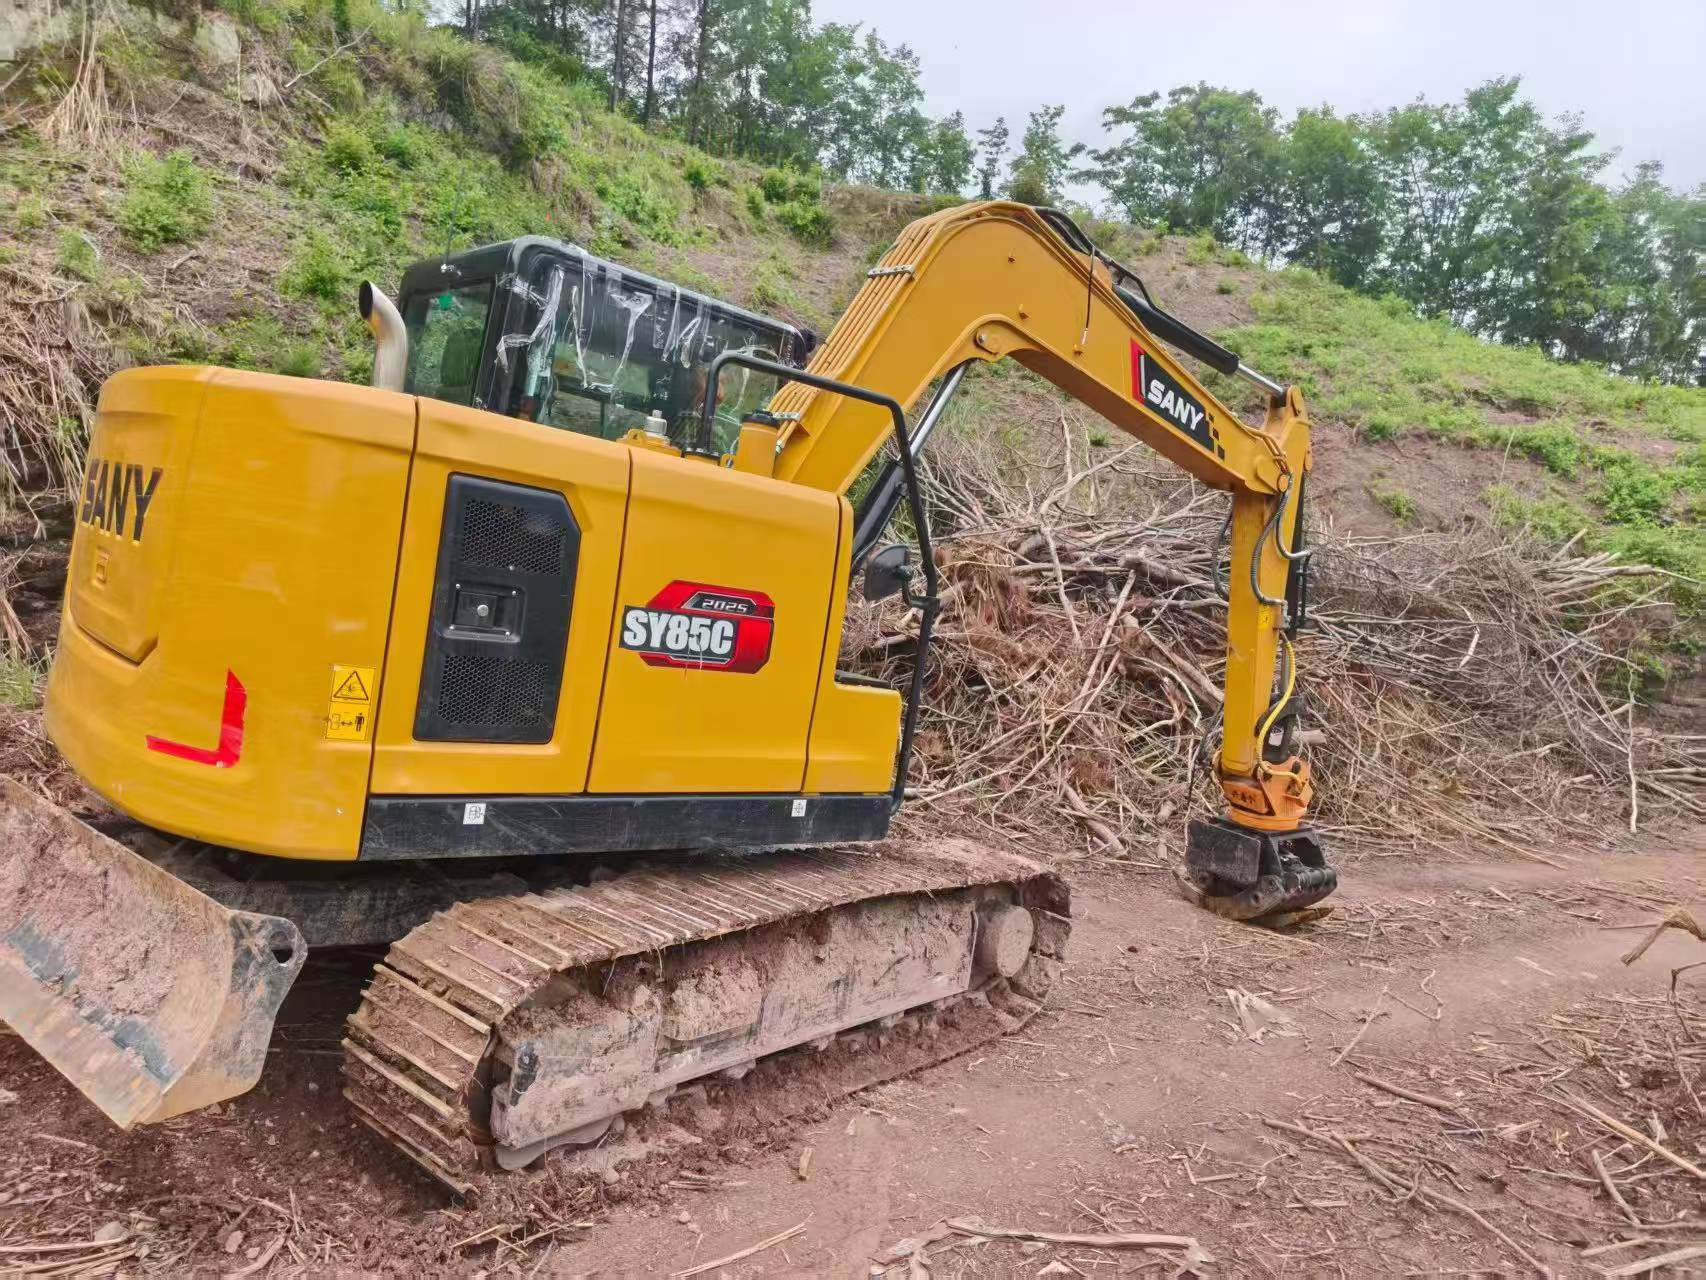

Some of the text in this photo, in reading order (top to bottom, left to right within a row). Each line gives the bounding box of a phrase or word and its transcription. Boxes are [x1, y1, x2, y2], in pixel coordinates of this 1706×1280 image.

[1148, 379, 1204, 431] SANY
[82, 458, 164, 542] SANY
[702, 598, 749, 613] 2025
[623, 609, 734, 655] SY85C
